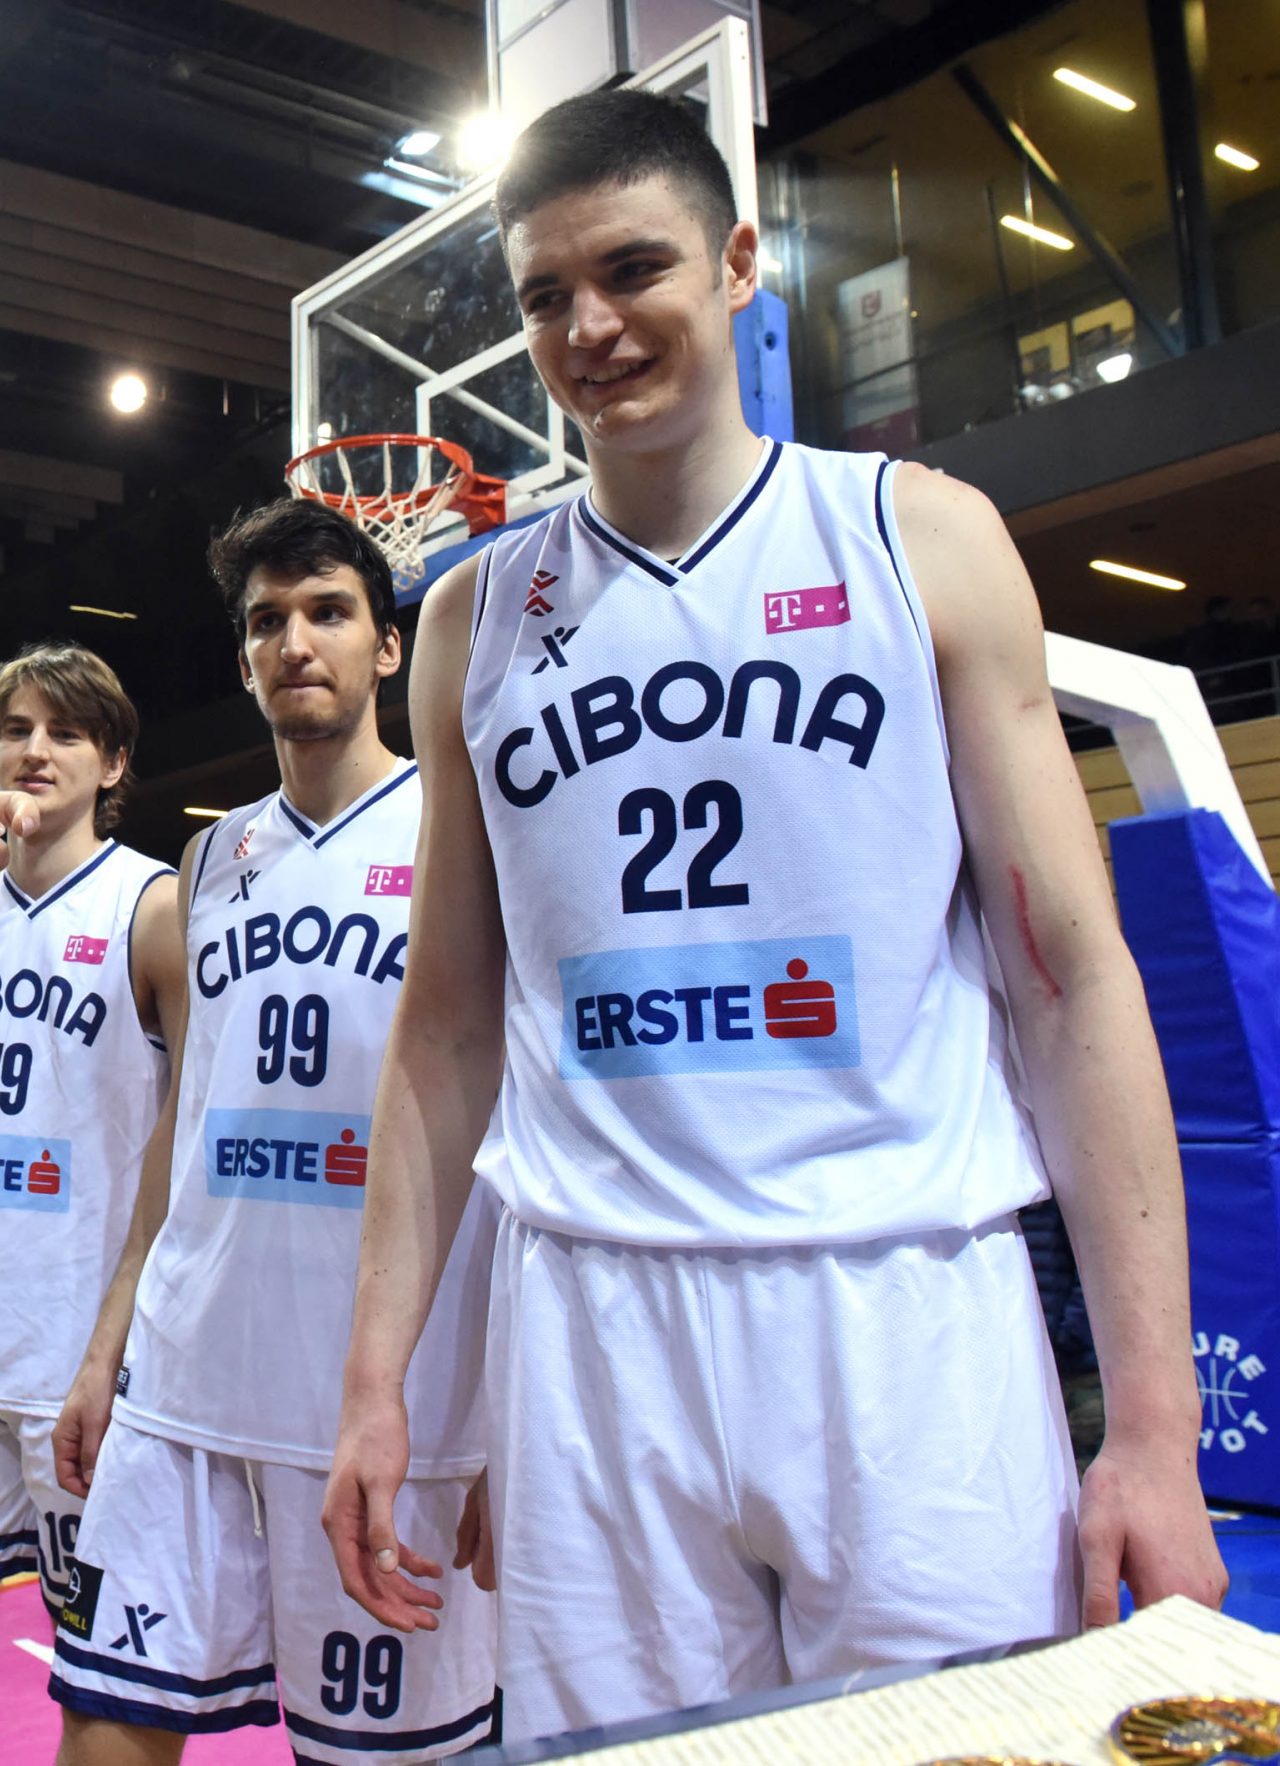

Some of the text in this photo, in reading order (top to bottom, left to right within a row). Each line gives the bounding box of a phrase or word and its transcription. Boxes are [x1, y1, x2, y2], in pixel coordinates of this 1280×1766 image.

[494, 659, 886, 809] CIBONA
[617, 779, 750, 915] 22
[256, 993, 330, 1088] 99
[575, 984, 754, 1052] ERSTE
[216, 1137, 320, 1183] ERSTE
[1191, 1331, 1268, 1381] URE
[321, 1629, 404, 1720] 99
